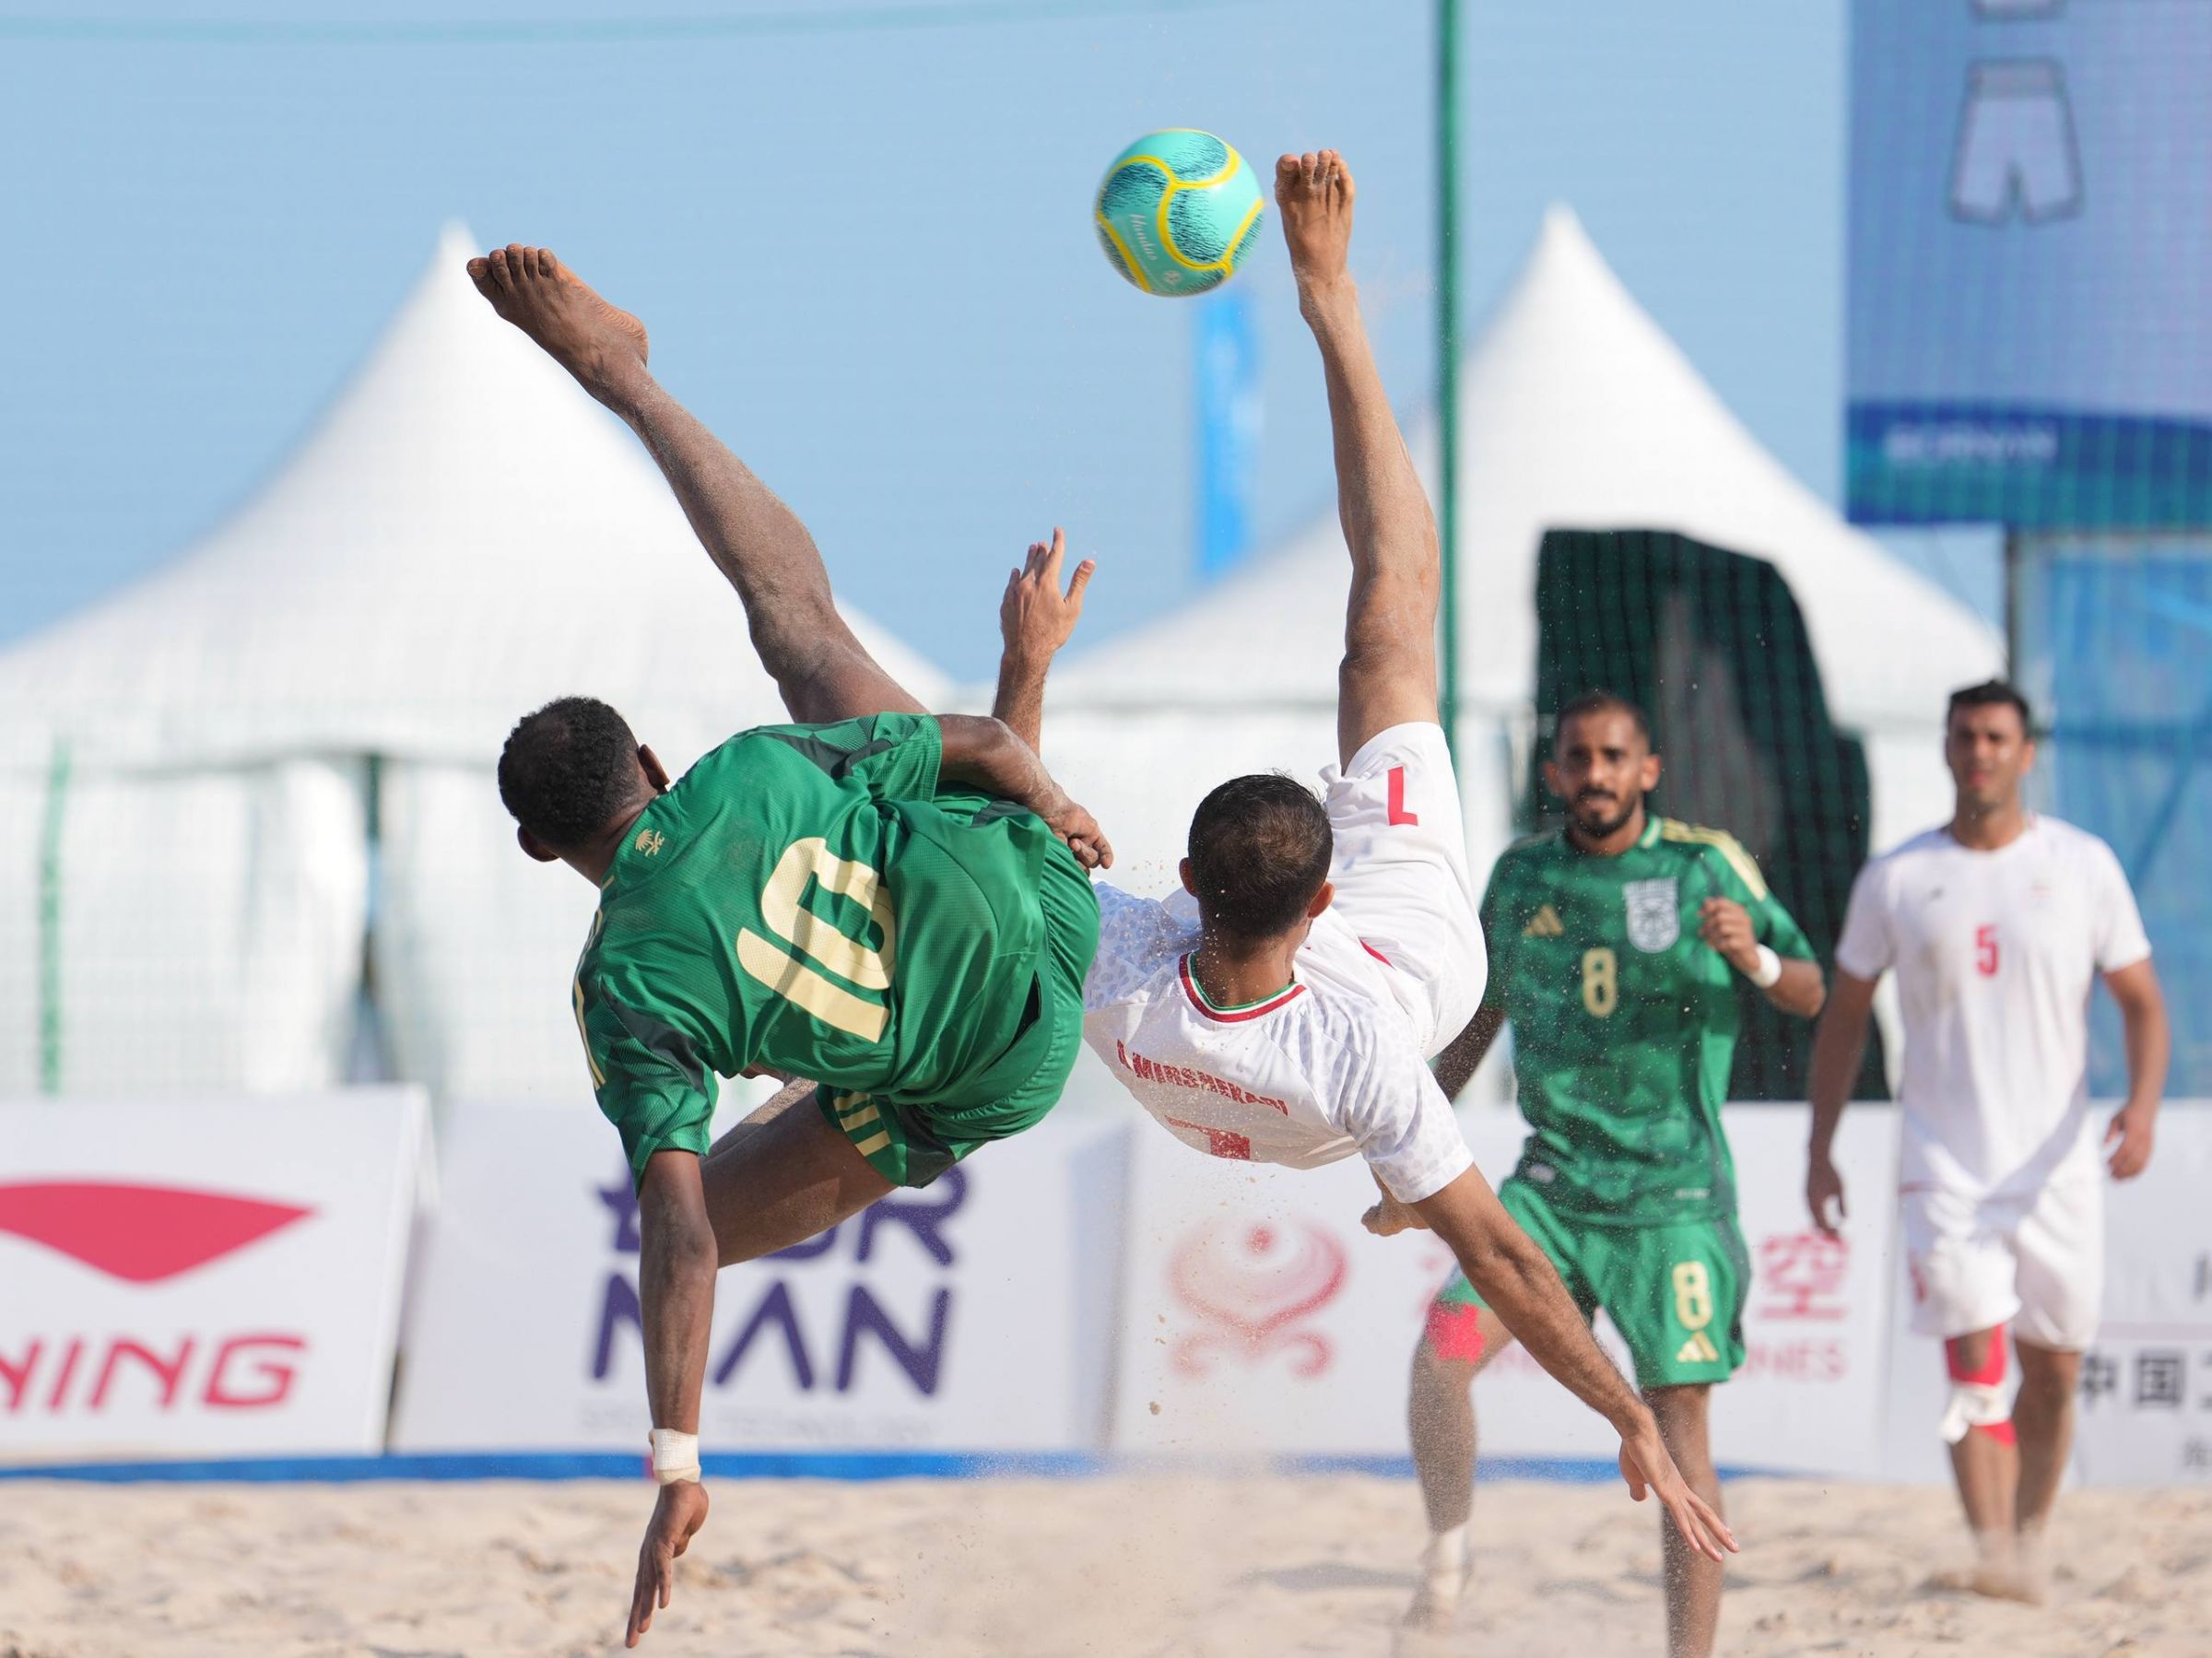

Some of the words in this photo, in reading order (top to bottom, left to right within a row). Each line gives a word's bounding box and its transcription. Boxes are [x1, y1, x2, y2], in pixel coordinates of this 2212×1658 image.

[737, 837, 896, 1044] 10
[1975, 923, 2001, 978] 5
[1581, 947, 1618, 1017] 8
[1673, 1260, 1713, 1330] 8
